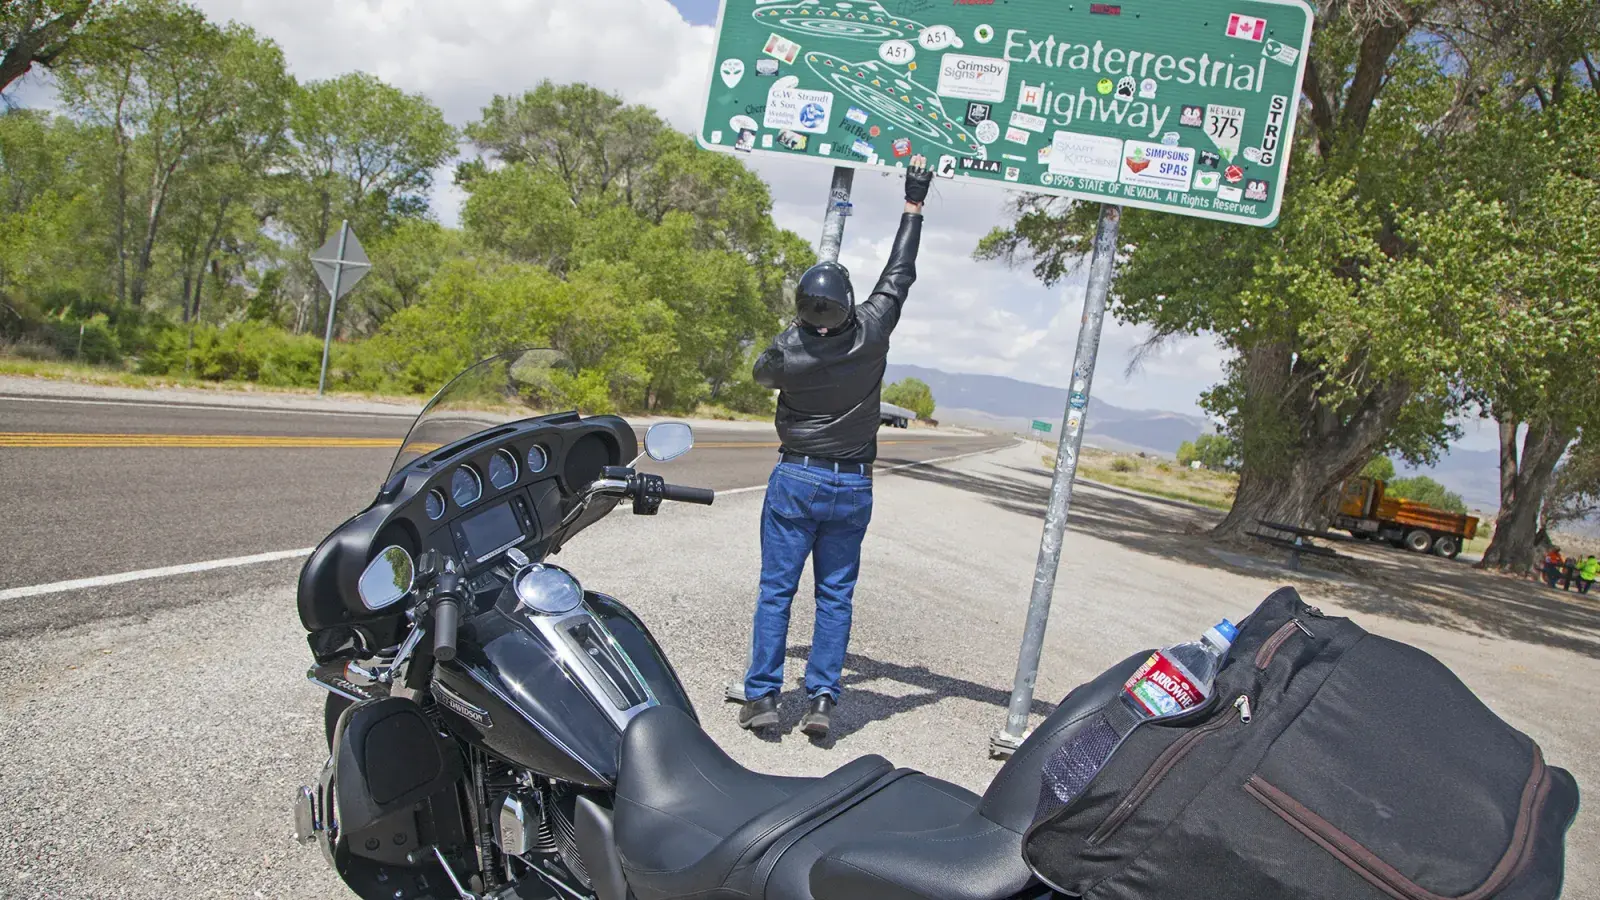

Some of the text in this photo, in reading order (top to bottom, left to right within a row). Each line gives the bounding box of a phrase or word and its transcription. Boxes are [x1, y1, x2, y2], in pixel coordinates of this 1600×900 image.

[926, 31, 948, 45] A51
[886, 46, 908, 59] A51
[957, 59, 1004, 76] Grimsby
[1003, 29, 1267, 94] Extraterrestrial
[944, 66, 976, 80] Signs
[1016, 79, 1171, 138] Highway
[1209, 106, 1242, 117] NEVADA
[1210, 115, 1239, 139] 375
[1260, 97, 1284, 165] STRUG
[1145, 147, 1190, 162] SIMPSONS
[1159, 163, 1188, 177] SPAS
[1077, 179, 1104, 192] STATE
[1108, 182, 1121, 194] OF
[1123, 184, 1162, 200] NEVADA.
[1166, 191, 1178, 202] All
[1180, 193, 1209, 209] Rights
[1212, 198, 1258, 215] Reserved.
